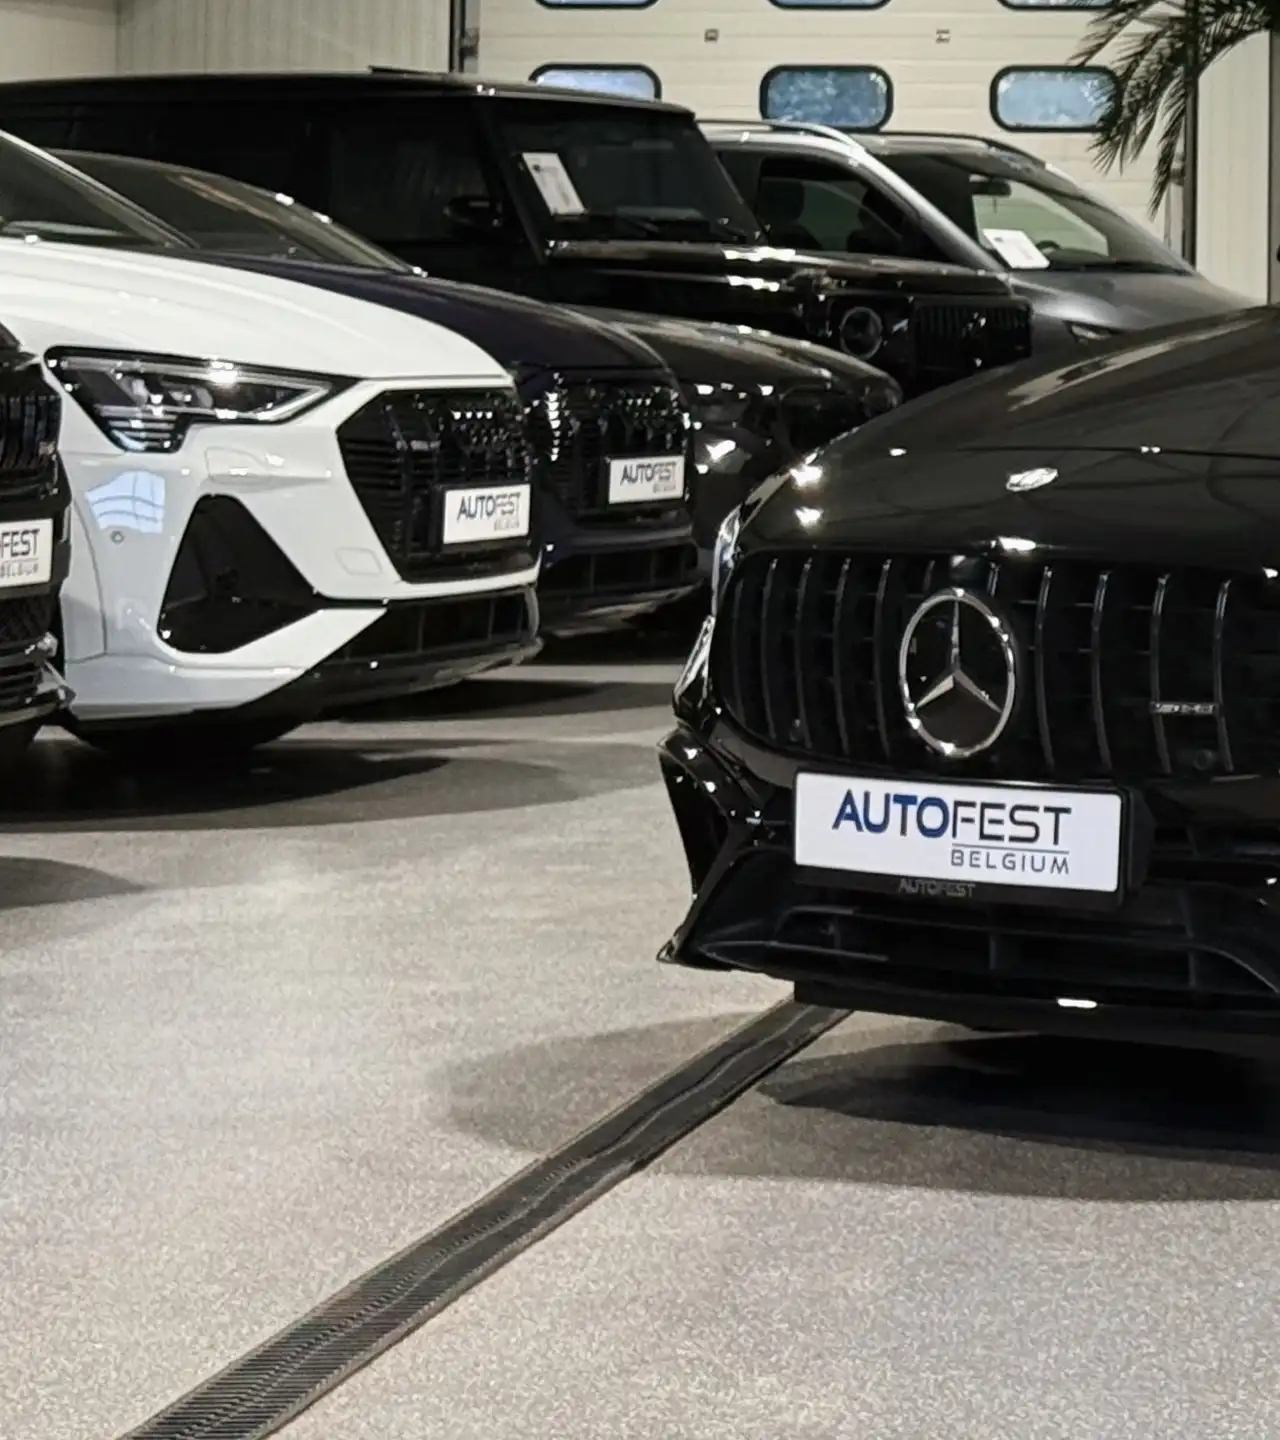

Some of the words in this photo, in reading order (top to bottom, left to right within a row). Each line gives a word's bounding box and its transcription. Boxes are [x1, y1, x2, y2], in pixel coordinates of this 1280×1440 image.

[456, 491, 522, 524] AUTOFEST
[0, 528, 41, 558] FEST
[832, 789, 1072, 845] AUTOFEST
[950, 848, 1070, 875] BELGIUM
[899, 877, 976, 897] AUTOFEST
